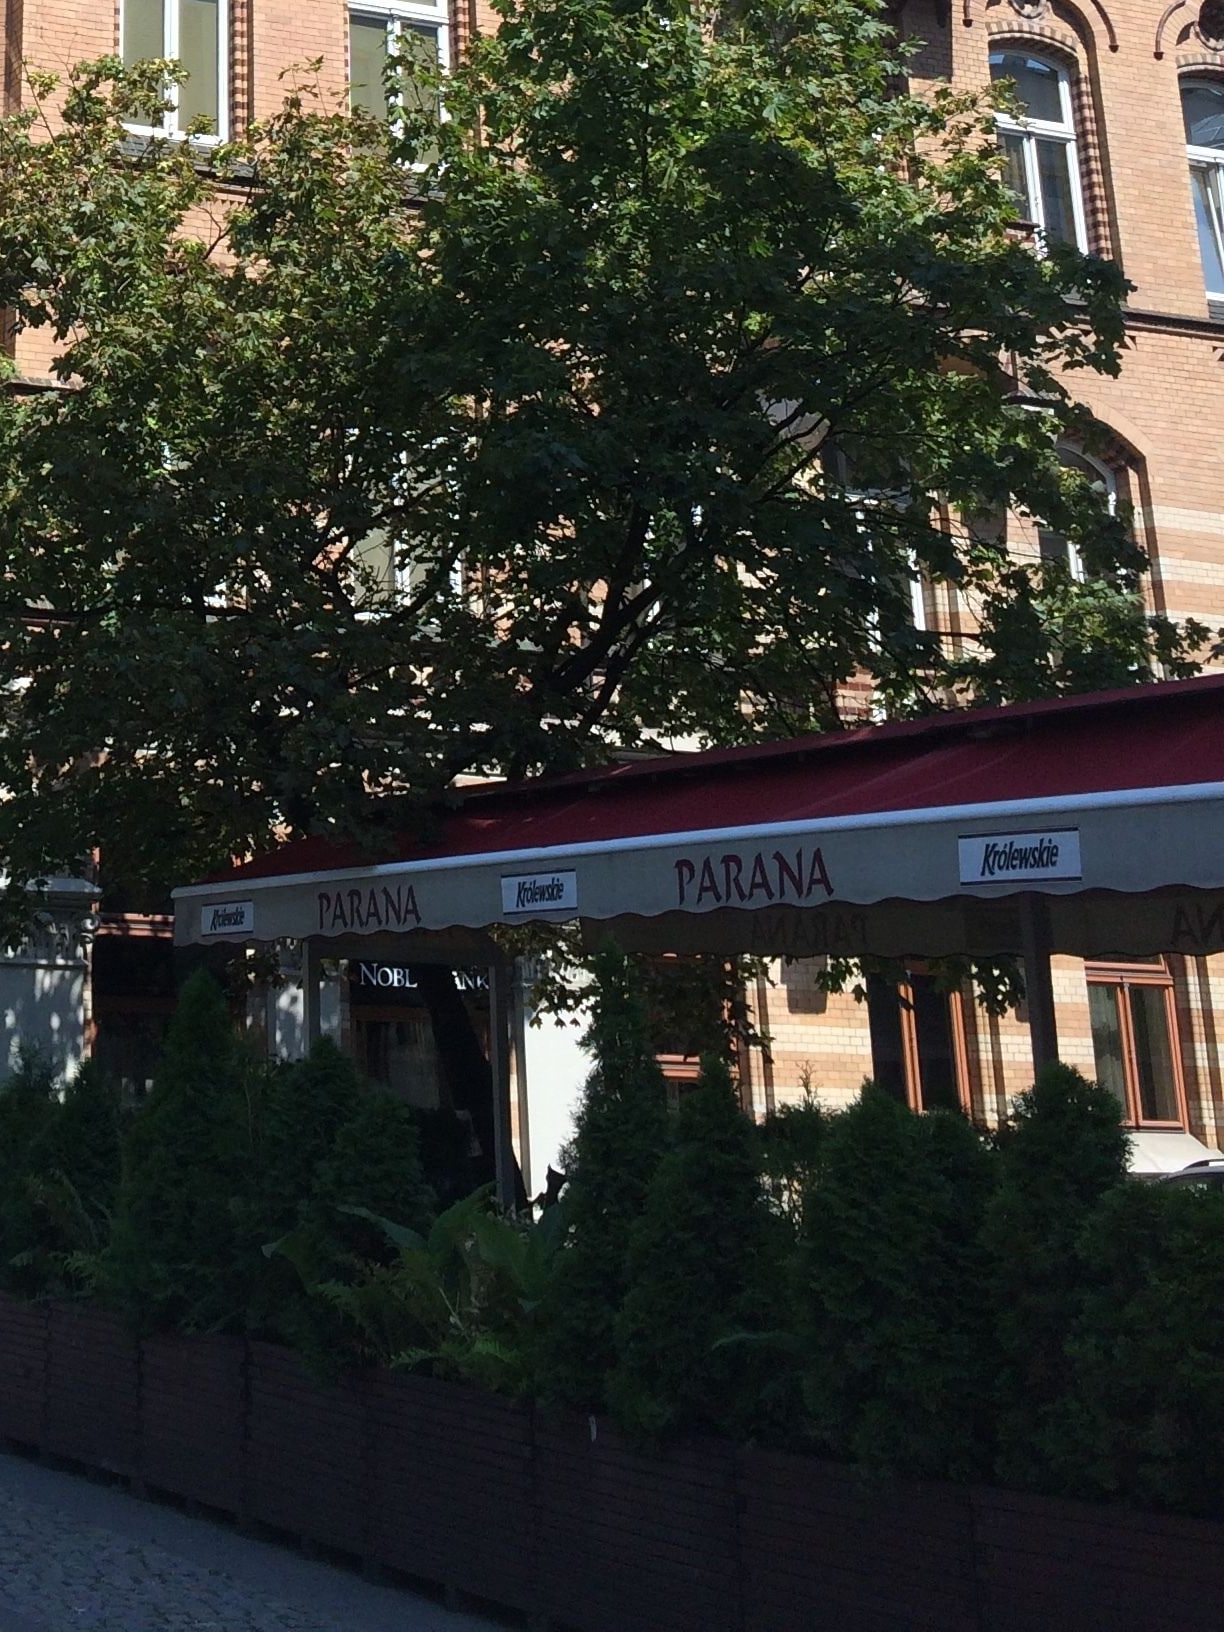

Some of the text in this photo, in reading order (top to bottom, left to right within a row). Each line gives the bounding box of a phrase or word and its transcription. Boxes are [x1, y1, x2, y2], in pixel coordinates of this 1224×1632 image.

[675, 847, 834, 905] PARANA
[980, 837, 1059, 877] Królewskie
[317, 884, 422, 930] PARANA
[515, 876, 564, 909] Królewskie
[360, 962, 418, 989] NOBL
